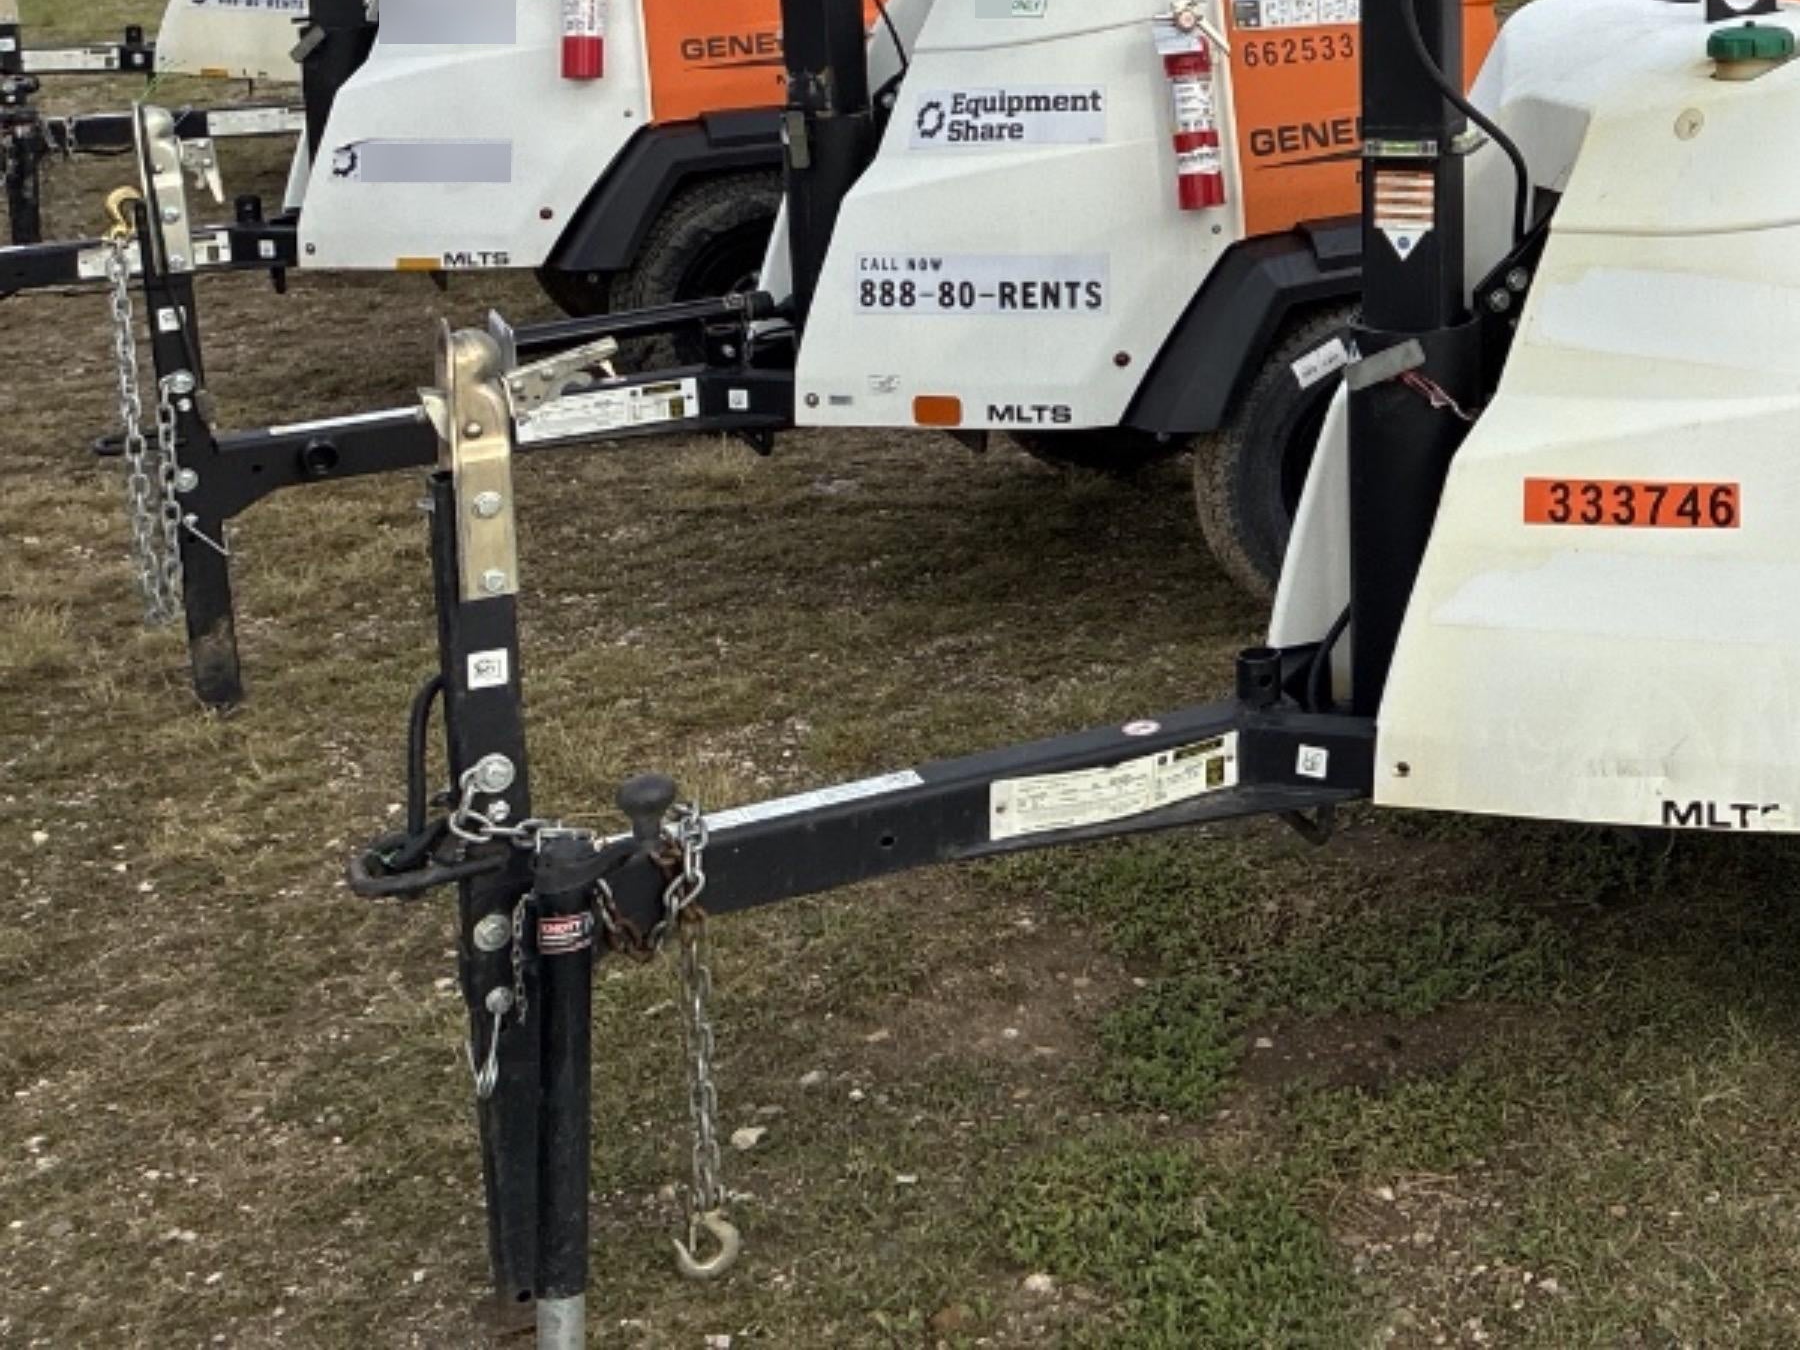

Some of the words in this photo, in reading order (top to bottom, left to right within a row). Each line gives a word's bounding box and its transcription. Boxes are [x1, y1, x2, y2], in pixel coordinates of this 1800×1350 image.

[680, 33, 783, 61] GENE
[1244, 33, 1354, 67] 662533
[951, 90, 1102, 118] Equipment
[948, 120, 1024, 142] Share
[1250, 116, 1362, 156] GENE
[443, 252, 509, 267] MLTS
[860, 257, 899, 271] CALL
[906, 258, 942, 271] NOW
[860, 279, 1102, 309] 888-80-RENTS
[986, 404, 1072, 423] MLTS
[1548, 481, 1735, 528] 333746
